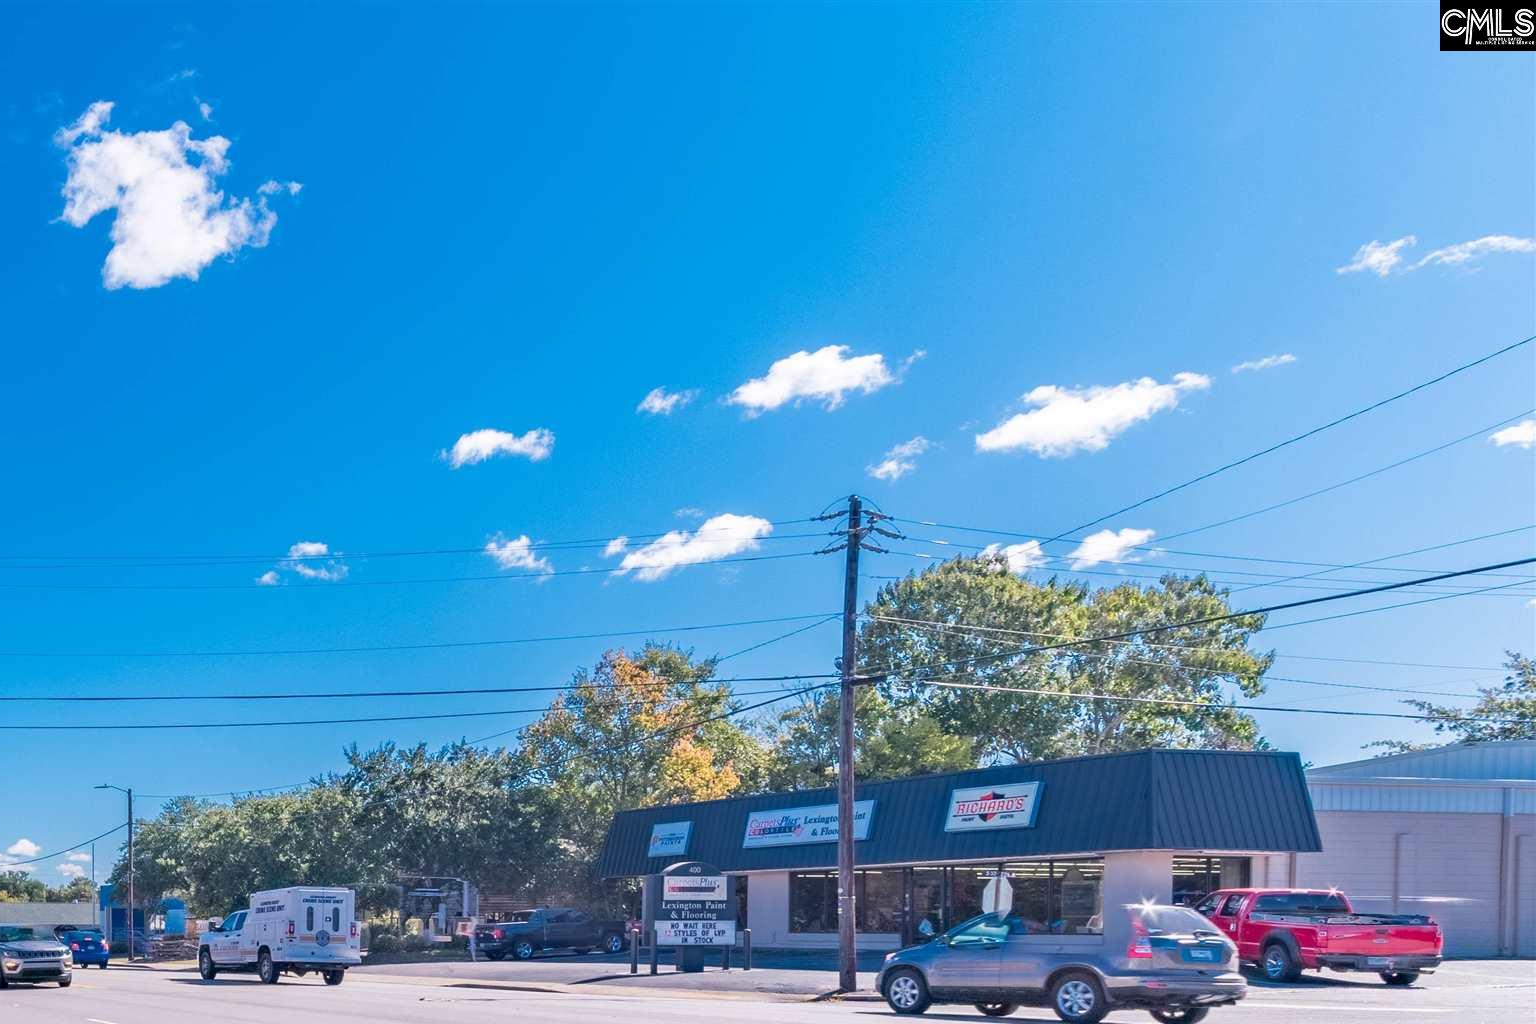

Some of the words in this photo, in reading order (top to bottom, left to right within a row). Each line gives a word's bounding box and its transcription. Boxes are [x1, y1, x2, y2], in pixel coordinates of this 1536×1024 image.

[957, 798, 1024, 814] RICHARD'S
[804, 815, 839, 825] Lexingto
[811, 828, 818, 836] &
[689, 866, 702, 874] 400
[662, 901, 702, 911] Lexington
[706, 901, 726, 910] Paint
[670, 911, 679, 919] &
[682, 911, 717, 920] Flooring
